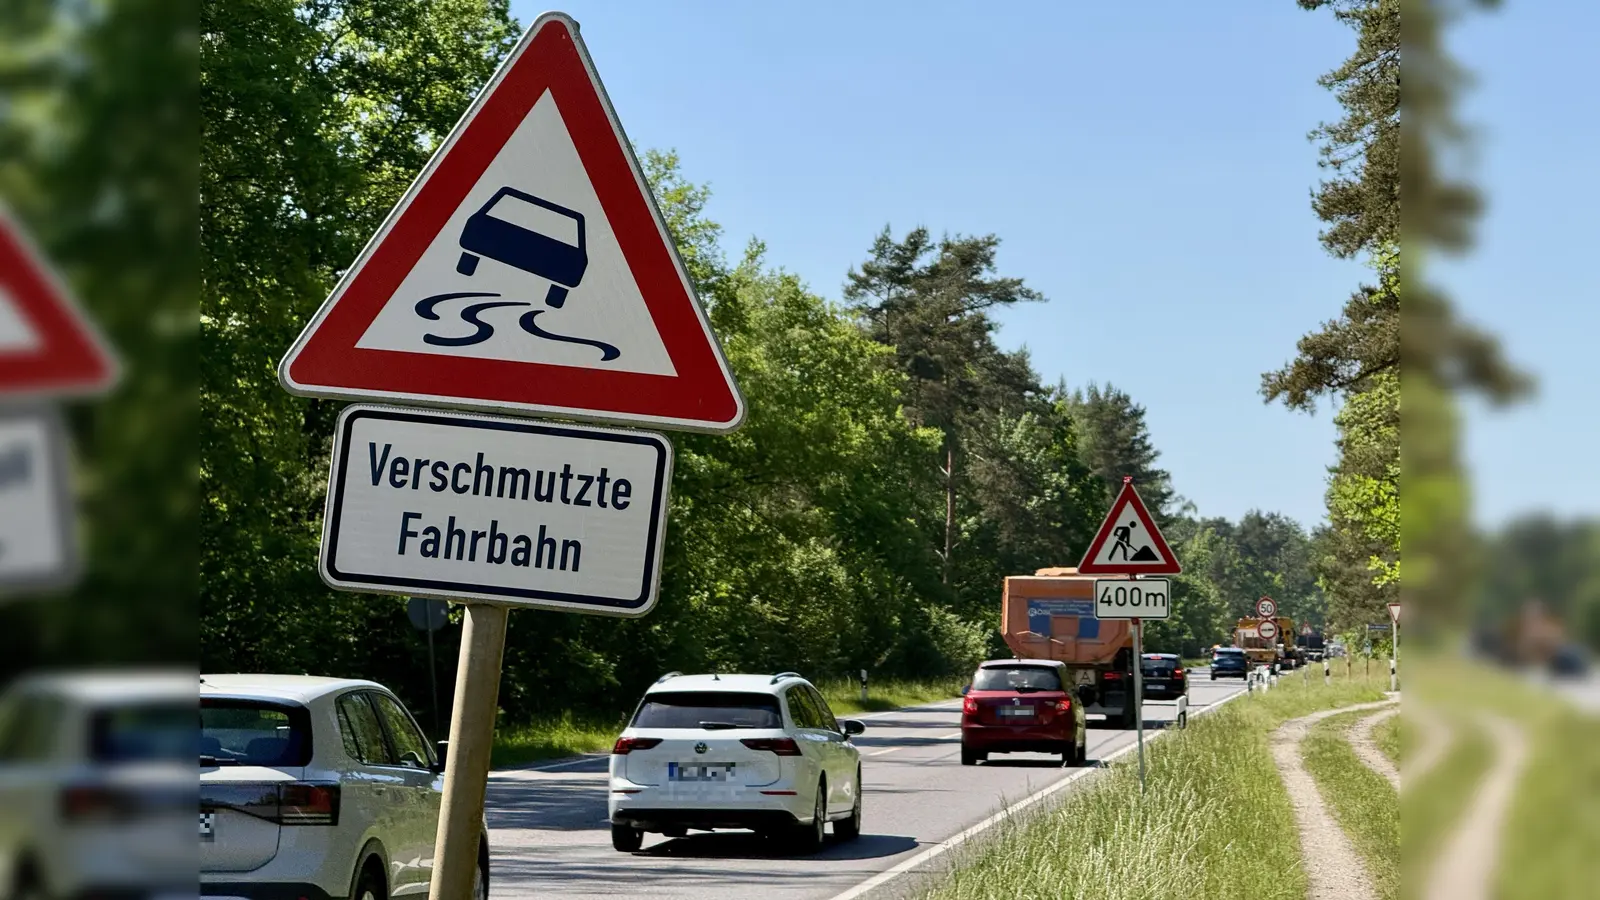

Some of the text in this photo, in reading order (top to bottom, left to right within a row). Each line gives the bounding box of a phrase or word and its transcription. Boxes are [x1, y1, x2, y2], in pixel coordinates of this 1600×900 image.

[369, 442, 632, 510] Verschmutzte
[398, 512, 582, 572] Fahrbahn
[1099, 586, 1166, 607] 400m
[1260, 603, 1273, 614] 50
[1080, 671, 1092, 683] A
